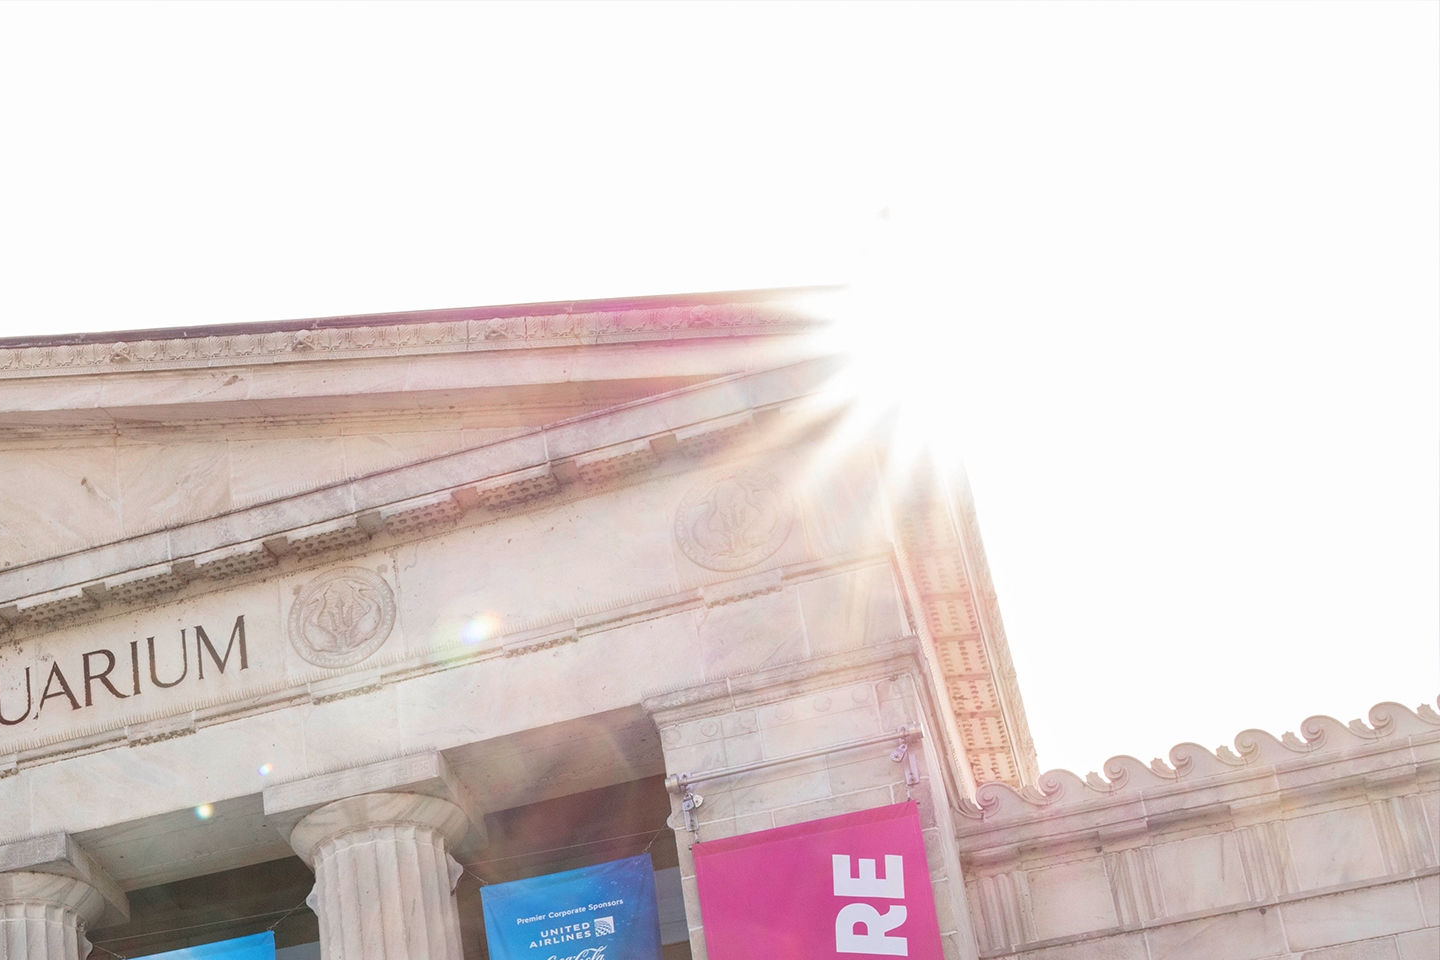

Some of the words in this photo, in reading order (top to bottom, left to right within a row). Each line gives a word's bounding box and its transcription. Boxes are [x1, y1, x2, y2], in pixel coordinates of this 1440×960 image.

[516, 915, 546, 925] Premier
[548, 907, 586, 918] Corporate
[588, 899, 624, 911] Sponsors
[529, 930, 592, 949] AIRLINES
[540, 922, 591, 938] UNITED
